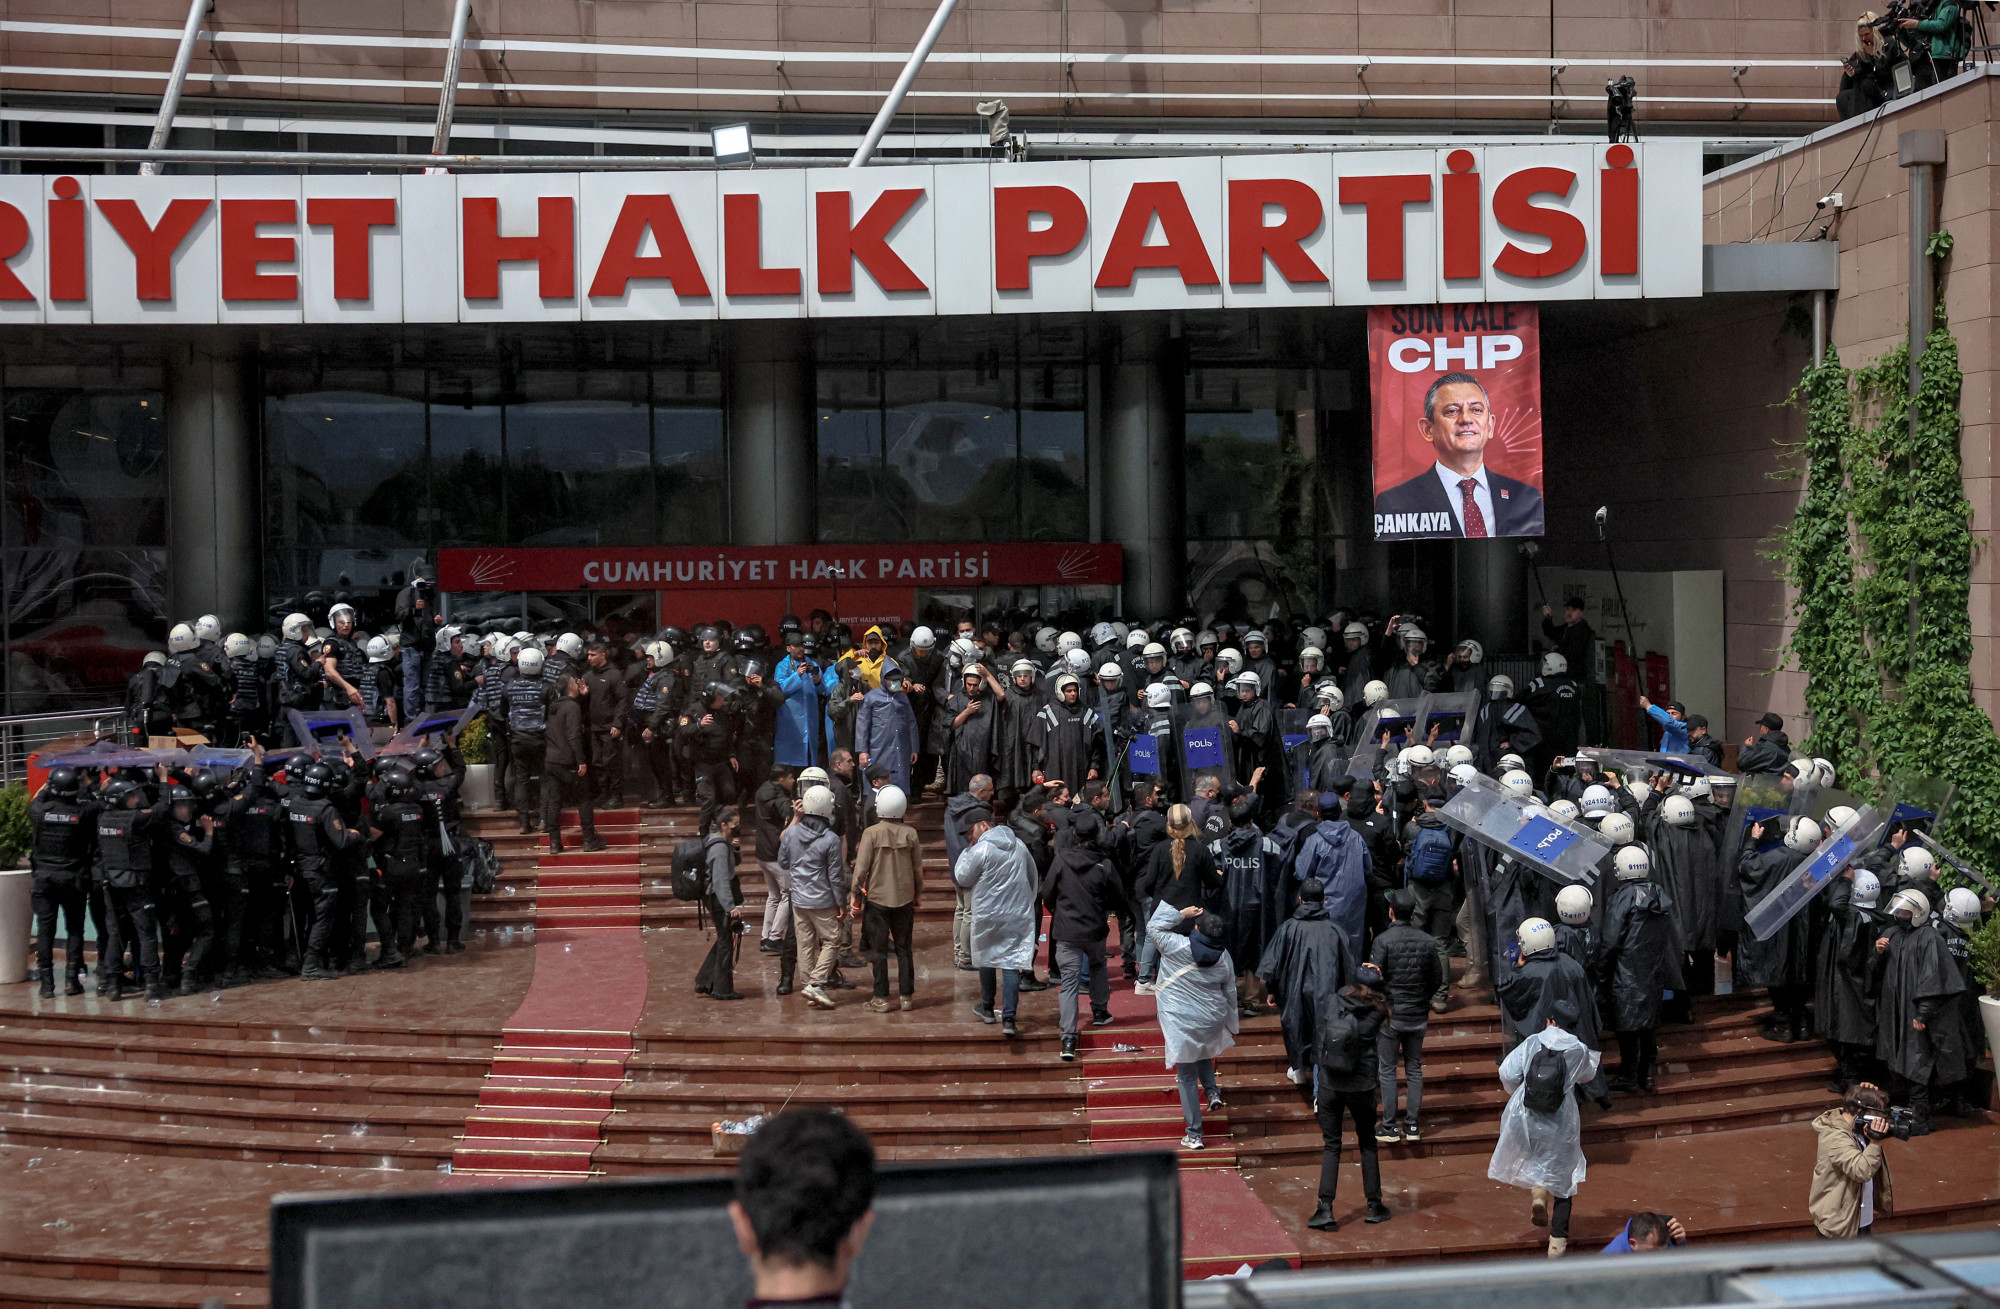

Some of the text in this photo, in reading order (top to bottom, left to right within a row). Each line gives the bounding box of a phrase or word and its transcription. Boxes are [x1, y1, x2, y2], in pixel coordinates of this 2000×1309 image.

[461, 188, 929, 300] HALK
[993, 144, 1639, 291] PARTİSİ
[1391, 303, 1518, 335] SON KALE
[1387, 334, 1524, 374] CHP
[1374, 511, 1452, 538] ÇANKAYA
[583, 550, 989, 583] CUMHURİYET HALK PARTİSİ
[1537, 828, 1563, 849] POLİS
[1224, 857, 1260, 869] POLİS
